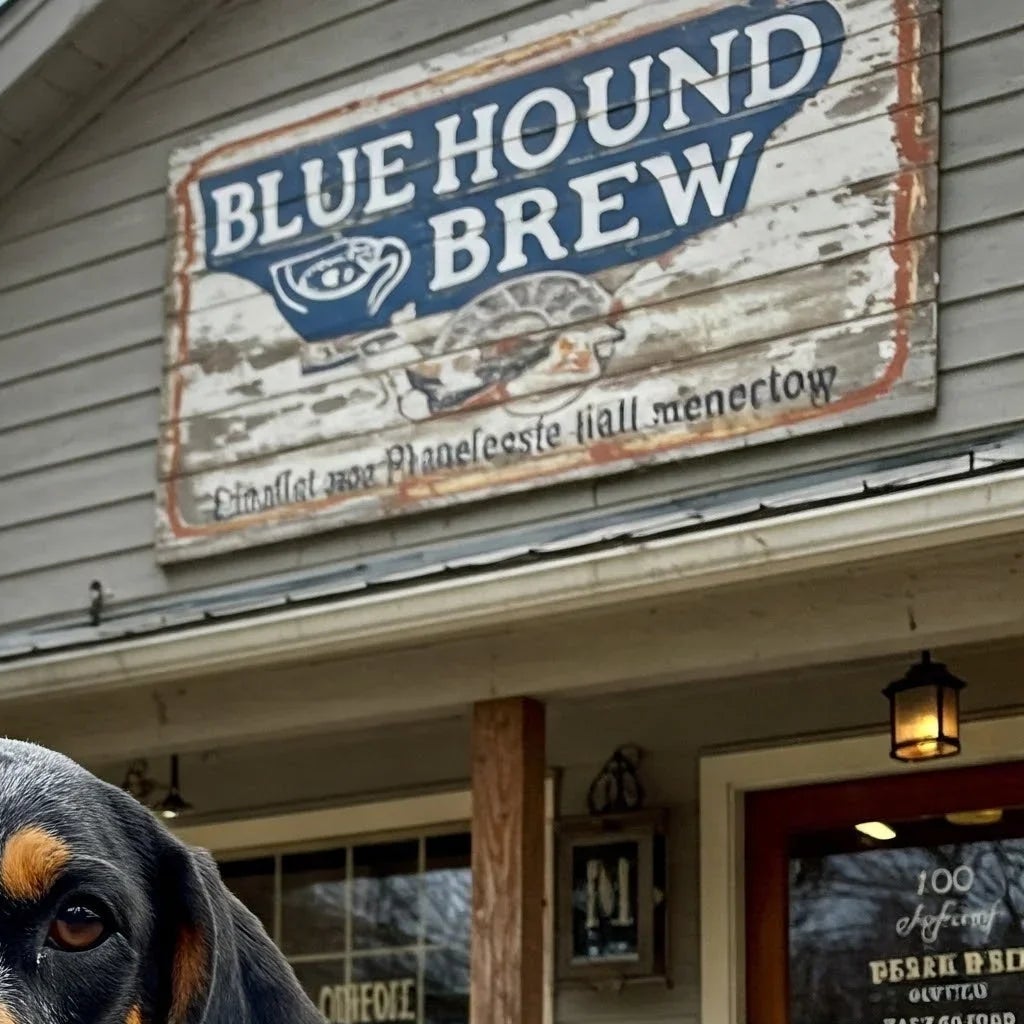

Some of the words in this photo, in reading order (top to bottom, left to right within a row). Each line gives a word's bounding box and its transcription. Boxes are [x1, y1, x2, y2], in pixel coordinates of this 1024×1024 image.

[211, 131, 415, 257] BLUE
[433, 14, 822, 194] HOUND
[429, 131, 754, 292] BREW
[917, 865, 974, 896] 100
